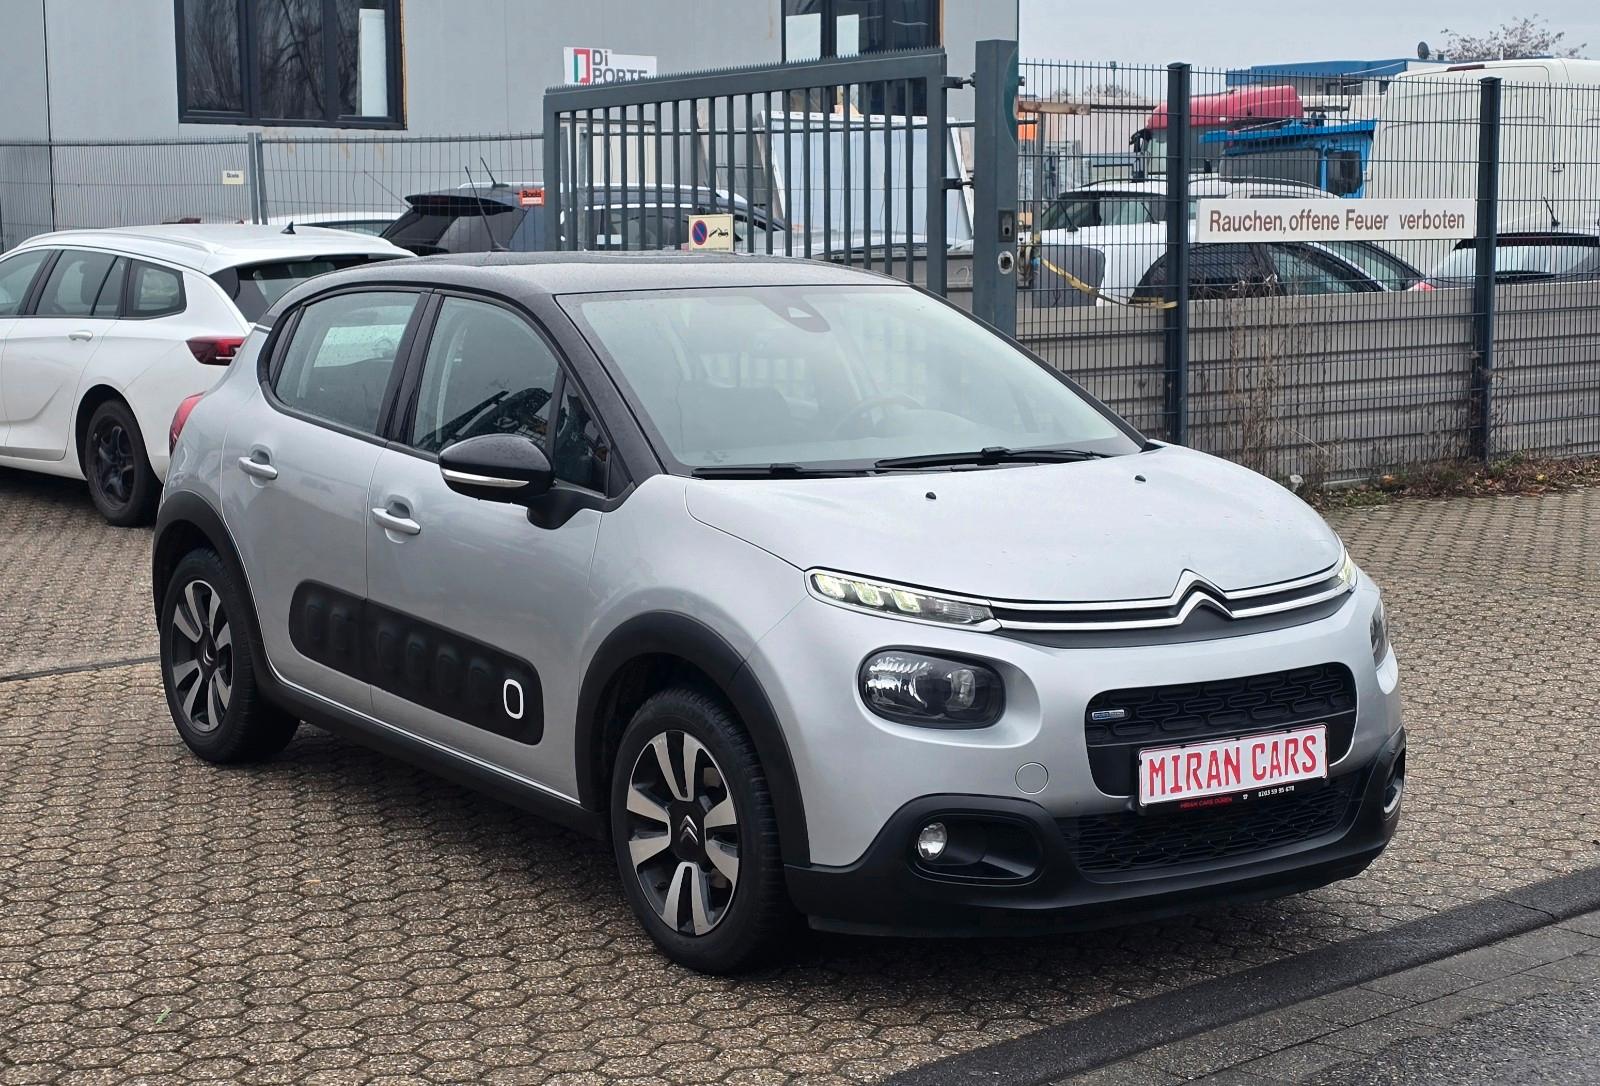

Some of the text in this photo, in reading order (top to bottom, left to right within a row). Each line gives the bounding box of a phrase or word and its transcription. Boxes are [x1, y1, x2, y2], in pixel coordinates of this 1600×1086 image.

[592, 49, 609, 66] Di
[1209, 208, 1465, 234] Rauchen, offene Feuer verboten
[1149, 734, 1317, 797] MIRAN CARS
